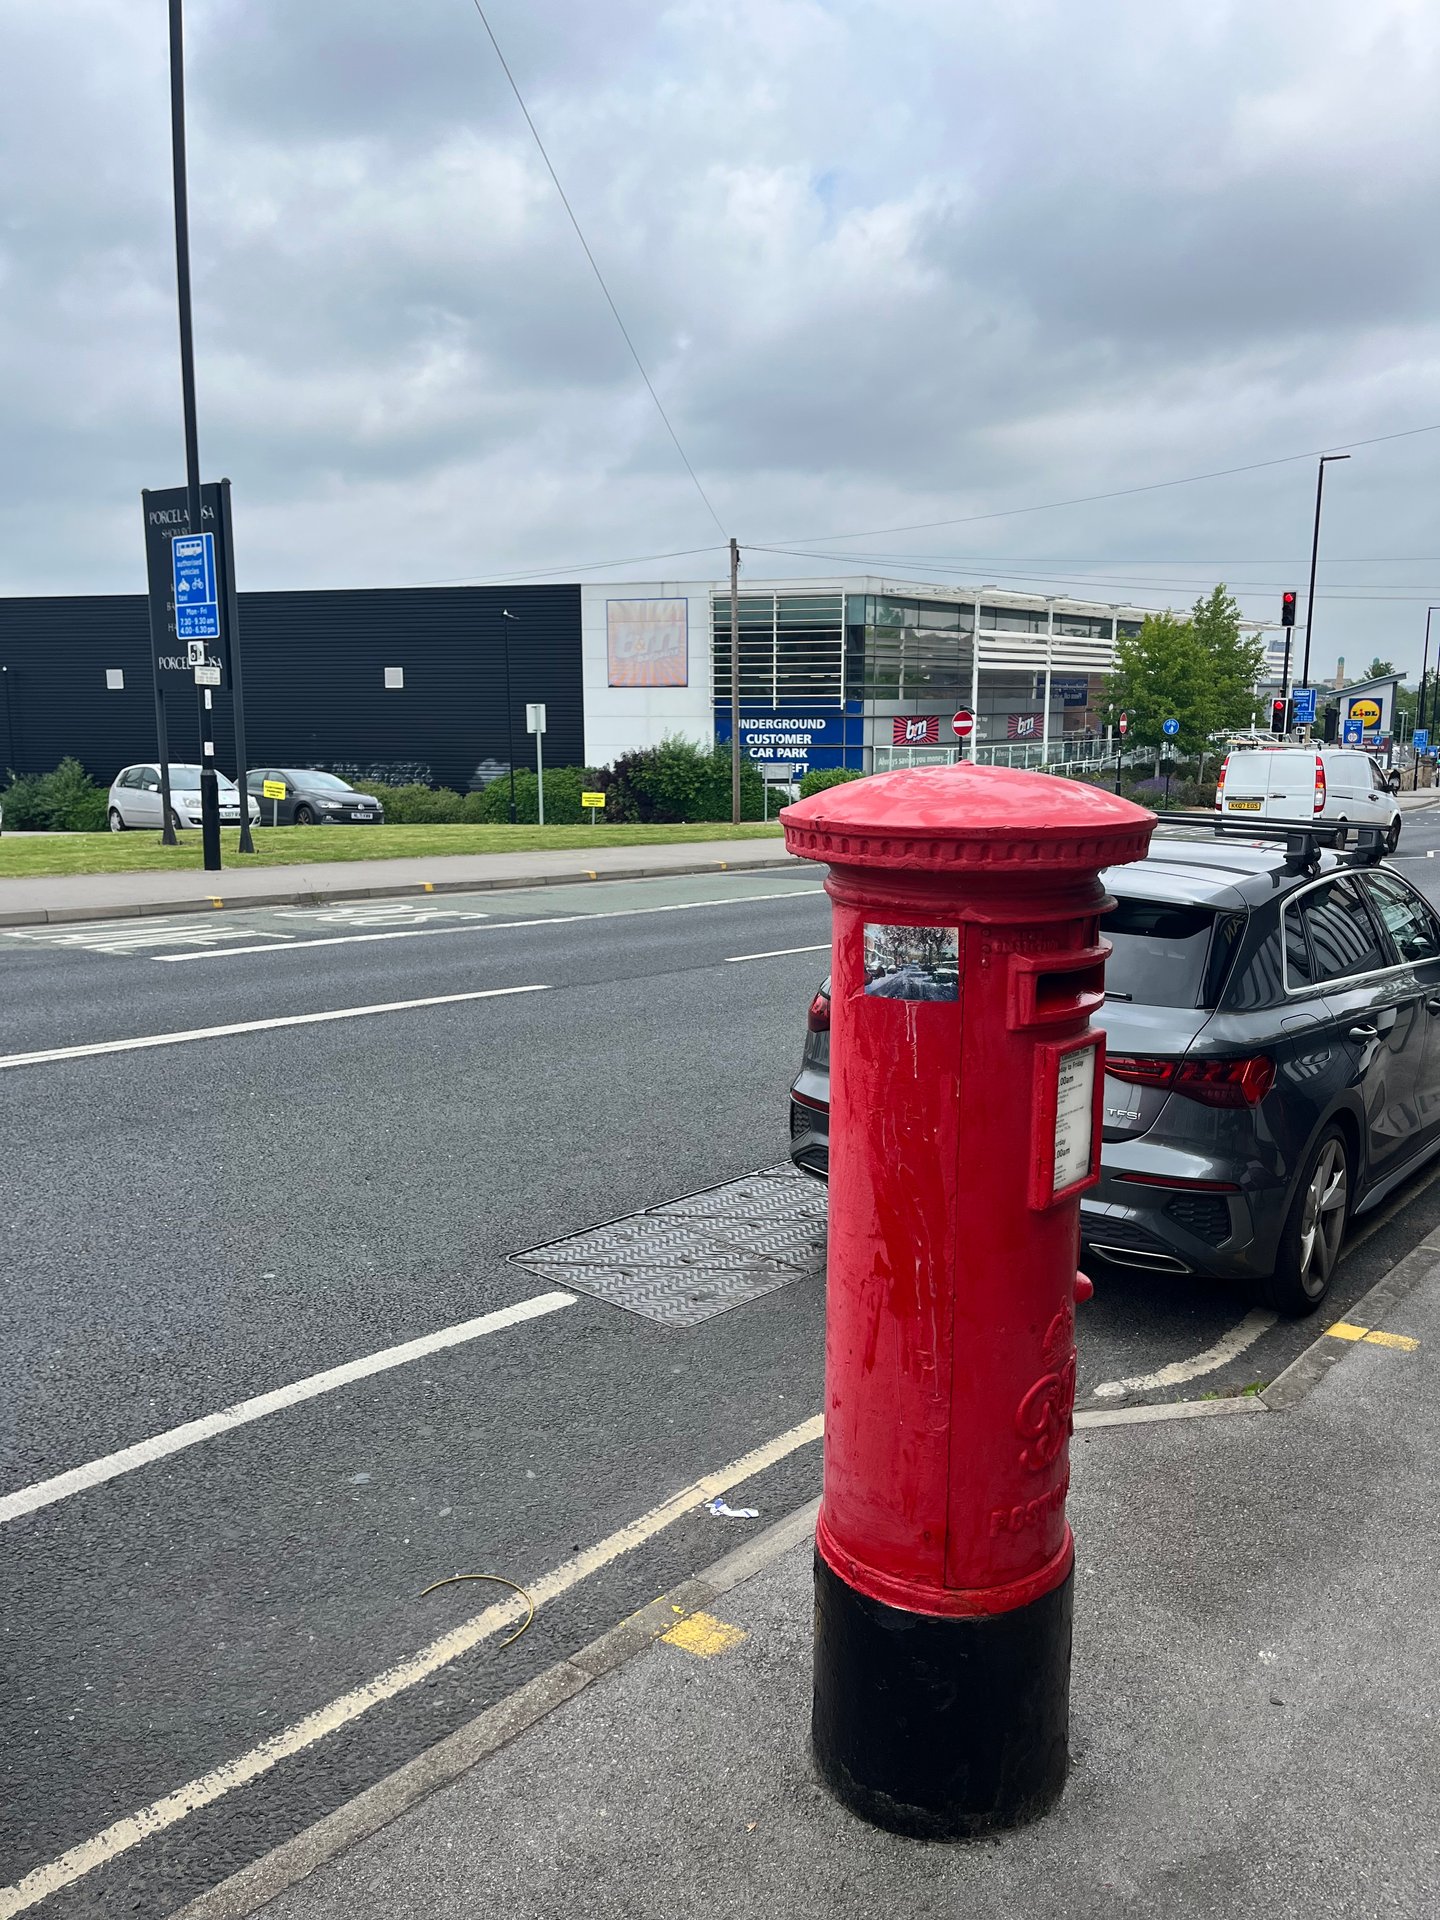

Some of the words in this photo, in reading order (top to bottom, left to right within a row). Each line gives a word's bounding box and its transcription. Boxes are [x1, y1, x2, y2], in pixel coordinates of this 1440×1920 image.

[149, 504, 214, 525] PORCELASA
[180, 568, 200, 576] vehicles
[194, 617, 207, 625] 9.30
[180, 627, 192, 635] 4.00
[195, 626, 207, 634] 6.30
[158, 656, 223, 669] PORCELSA
[738, 719, 826, 730] NDERGROUND
[746, 734, 812, 744] CUSTOMER
[749, 748, 774, 758] CAR
[776, 748, 808, 758] PARK
[273, 905, 489, 926] BUS
[1072, 1060, 1084, 1069] Friday
[1106, 1107, 1142, 1121] TFSI
